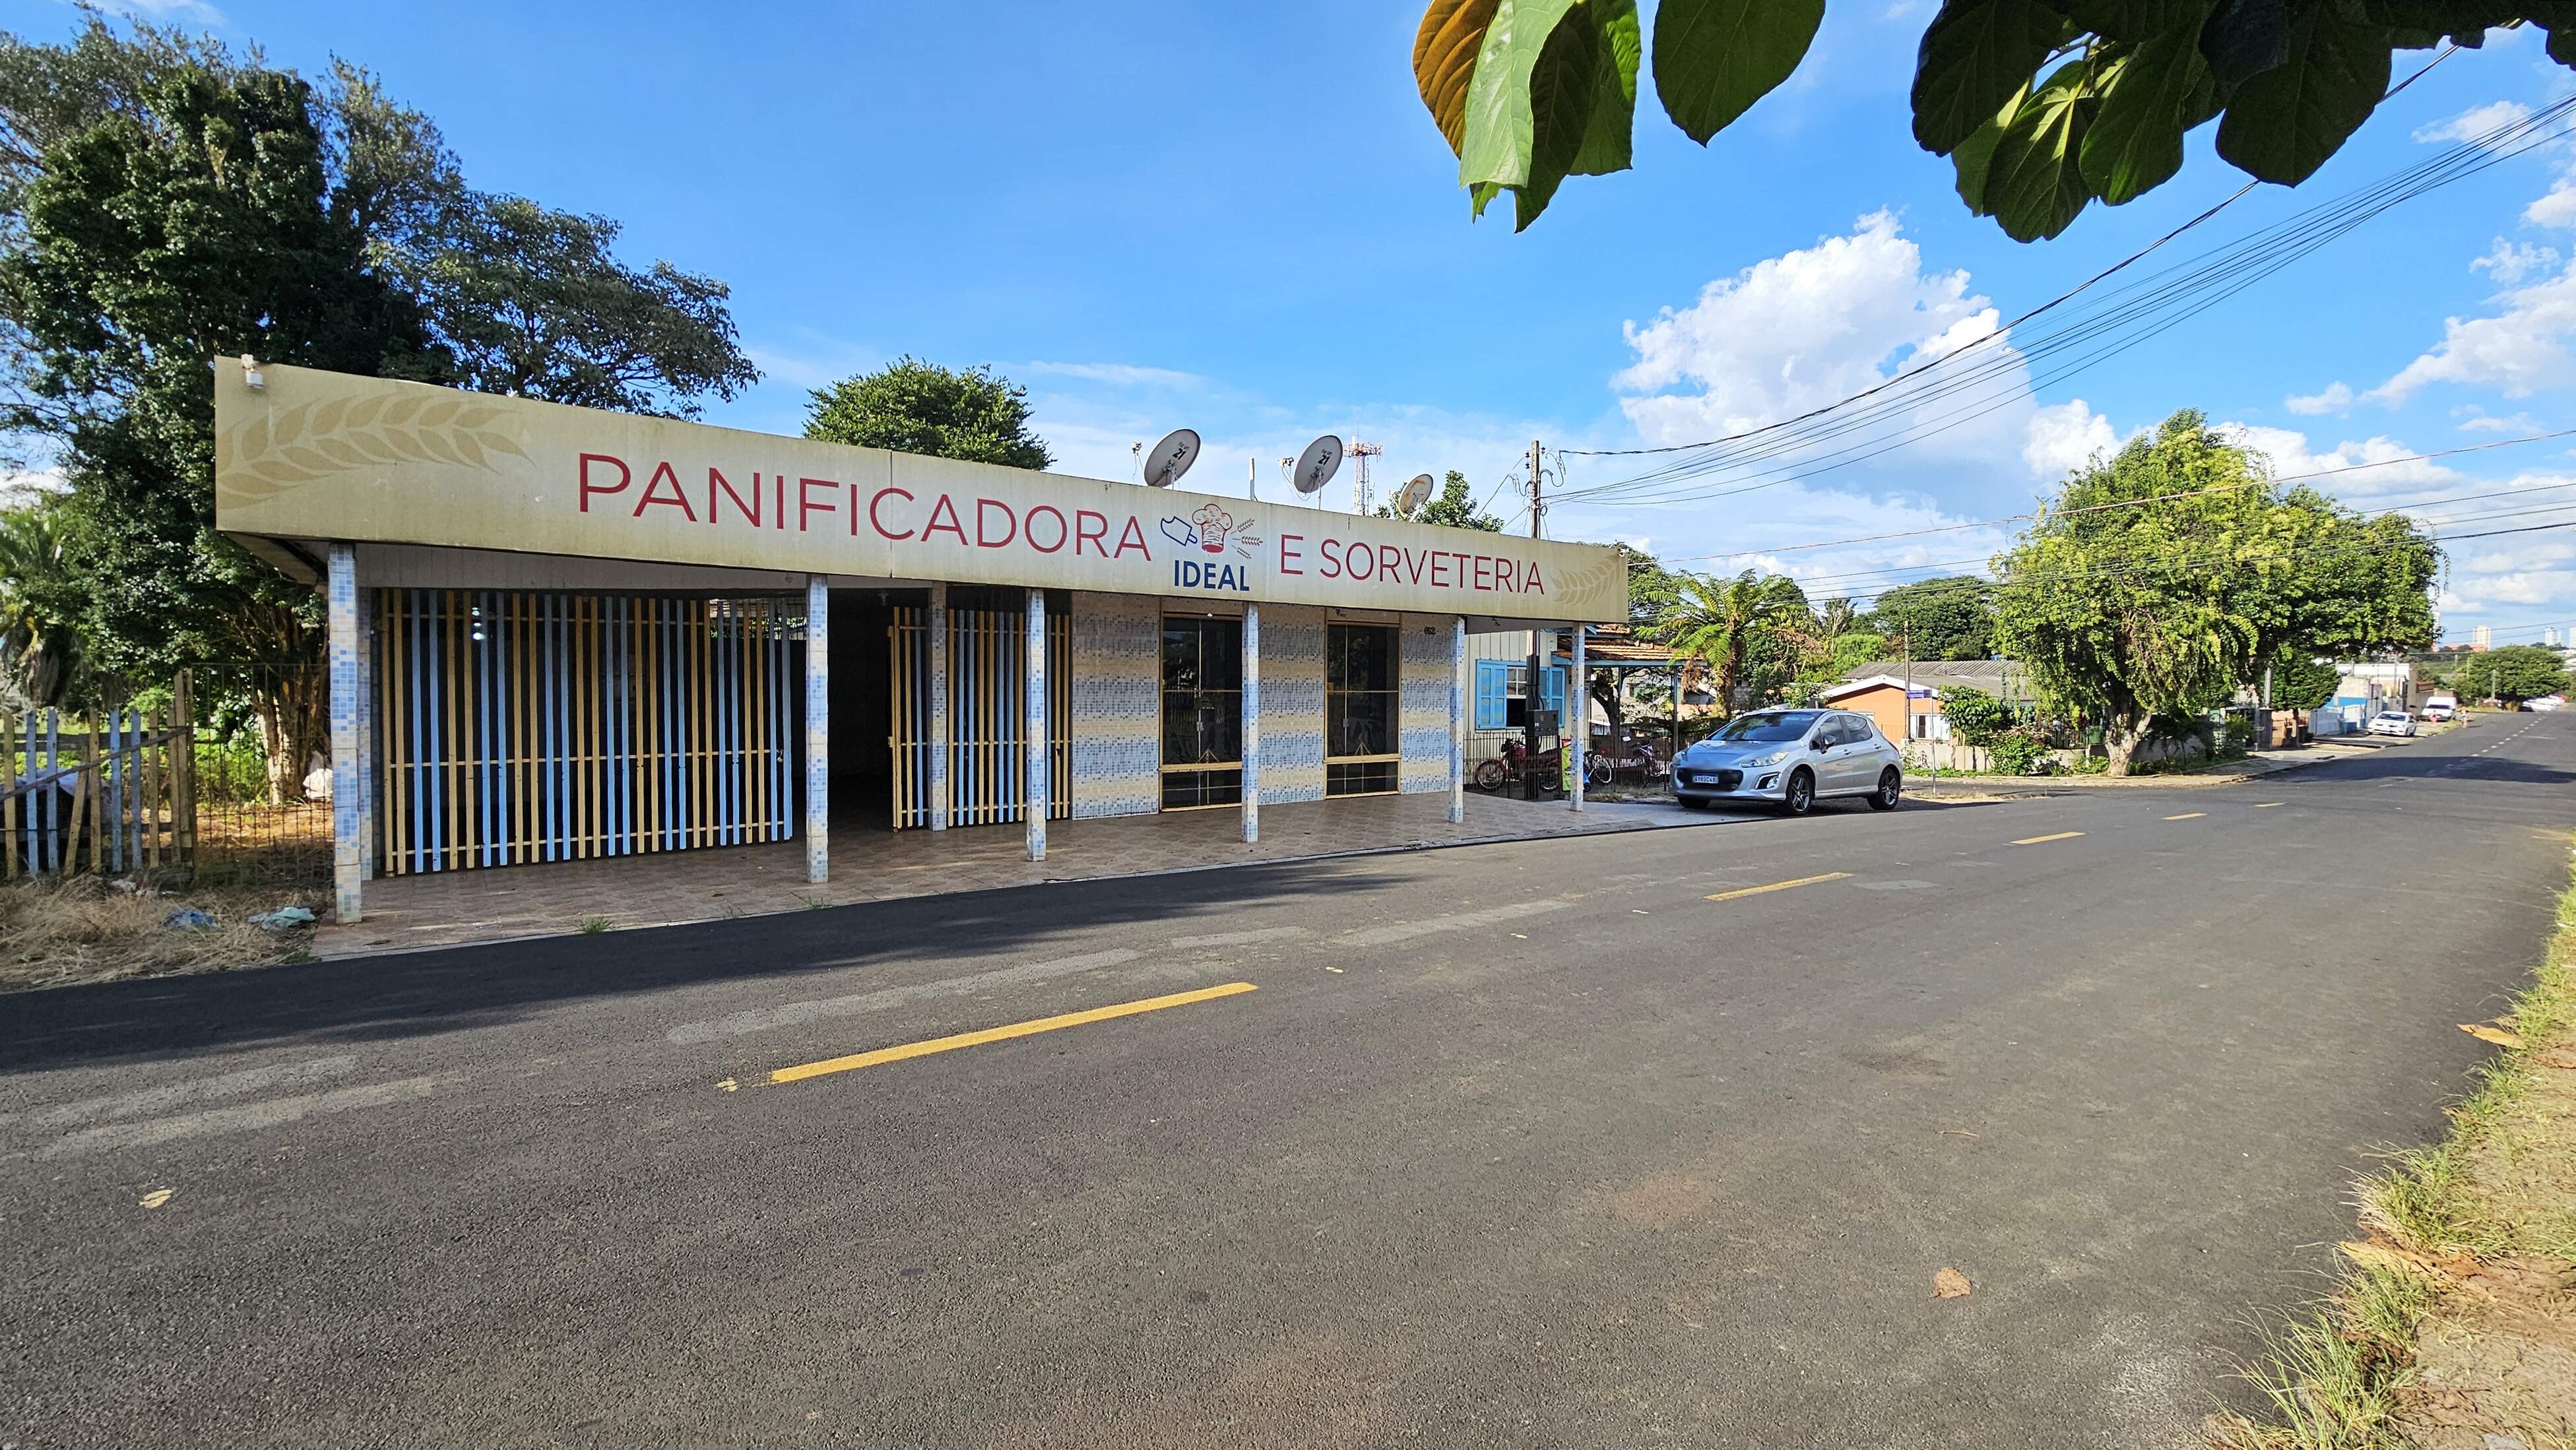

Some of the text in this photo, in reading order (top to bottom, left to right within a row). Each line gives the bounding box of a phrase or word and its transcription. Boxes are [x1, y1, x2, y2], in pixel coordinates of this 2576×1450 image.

[1173, 449, 1186, 460] 21
[1318, 455, 1330, 465] 21
[579, 453, 1151, 560] PANIFICADORA
[1175, 559, 1250, 591] IDEAL
[1281, 535, 1545, 595] E SORVETERIA
